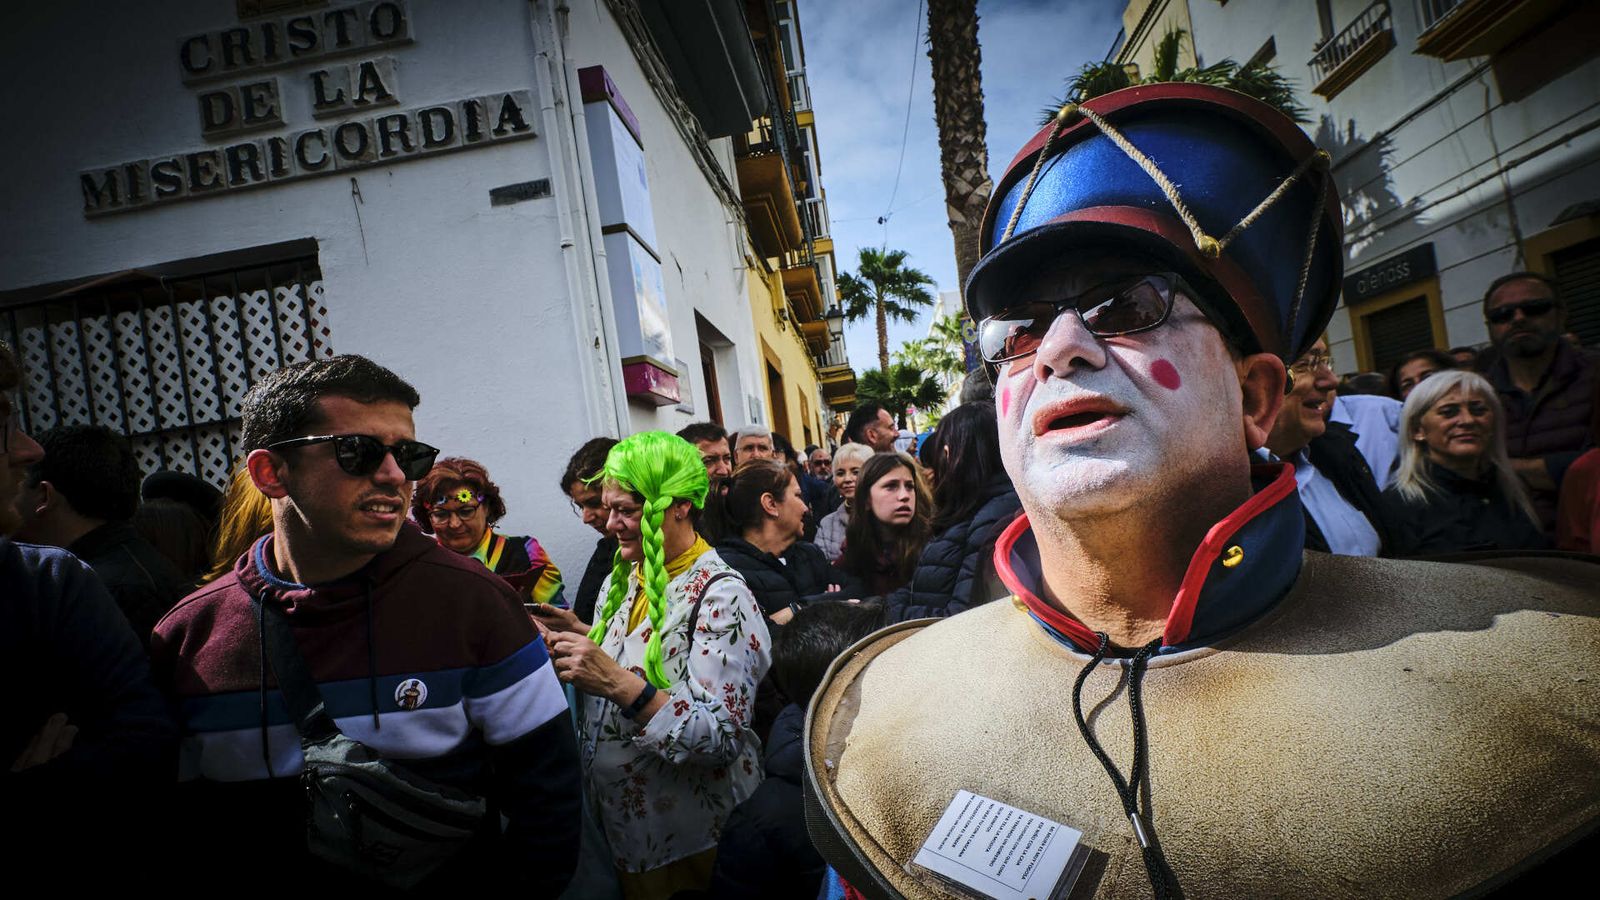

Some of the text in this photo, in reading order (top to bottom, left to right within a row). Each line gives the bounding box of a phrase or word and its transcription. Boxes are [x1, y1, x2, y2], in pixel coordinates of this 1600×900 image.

[181, 2, 402, 74] CRISTO
[201, 61, 395, 132] DE LA
[80, 93, 530, 210] MISERICORDIA
[999, 821, 1007, 830] TELA
[1006, 820, 1020, 838] TENEMOS
[1017, 825, 1029, 842] CUIDADO
[1031, 829, 1040, 840] NIÑO
[1041, 832, 1051, 846] MUJER
[989, 845, 1004, 867] GOBIERNO
[1016, 855, 1024, 866] CAJA
[1032, 852, 1040, 862] MUY
[1021, 862, 1034, 879] FOGOSA
